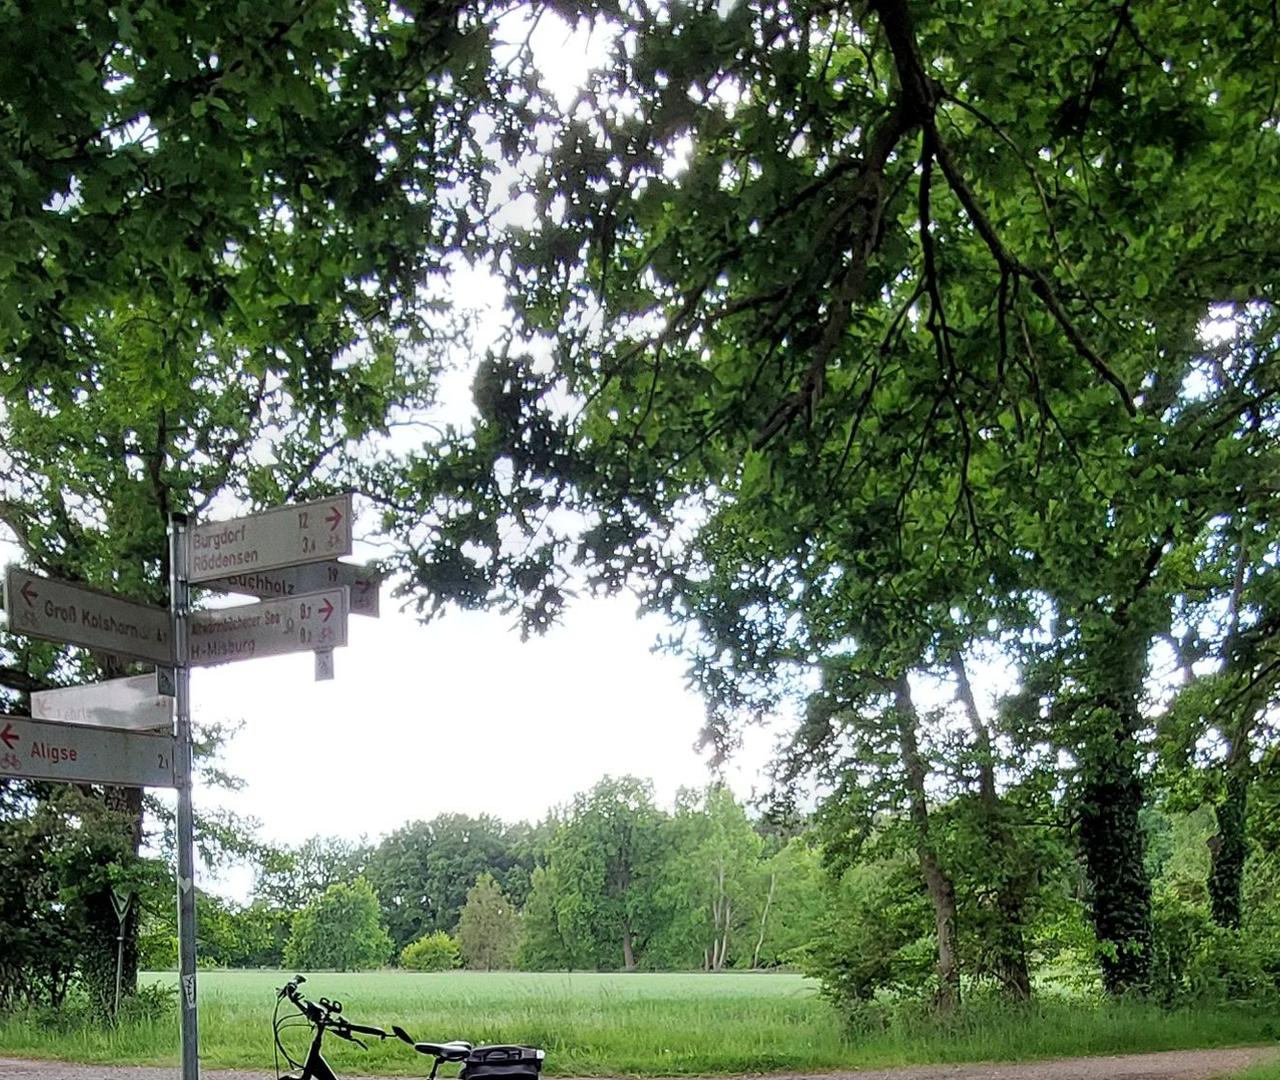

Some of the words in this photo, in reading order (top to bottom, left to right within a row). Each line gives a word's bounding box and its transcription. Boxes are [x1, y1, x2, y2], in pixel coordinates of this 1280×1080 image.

[193, 525, 246, 550] Burgdorf
[193, 550, 258, 573] Röddensen
[44, 600, 77, 624] Groß
[30, 741, 78, 764] Aligse
